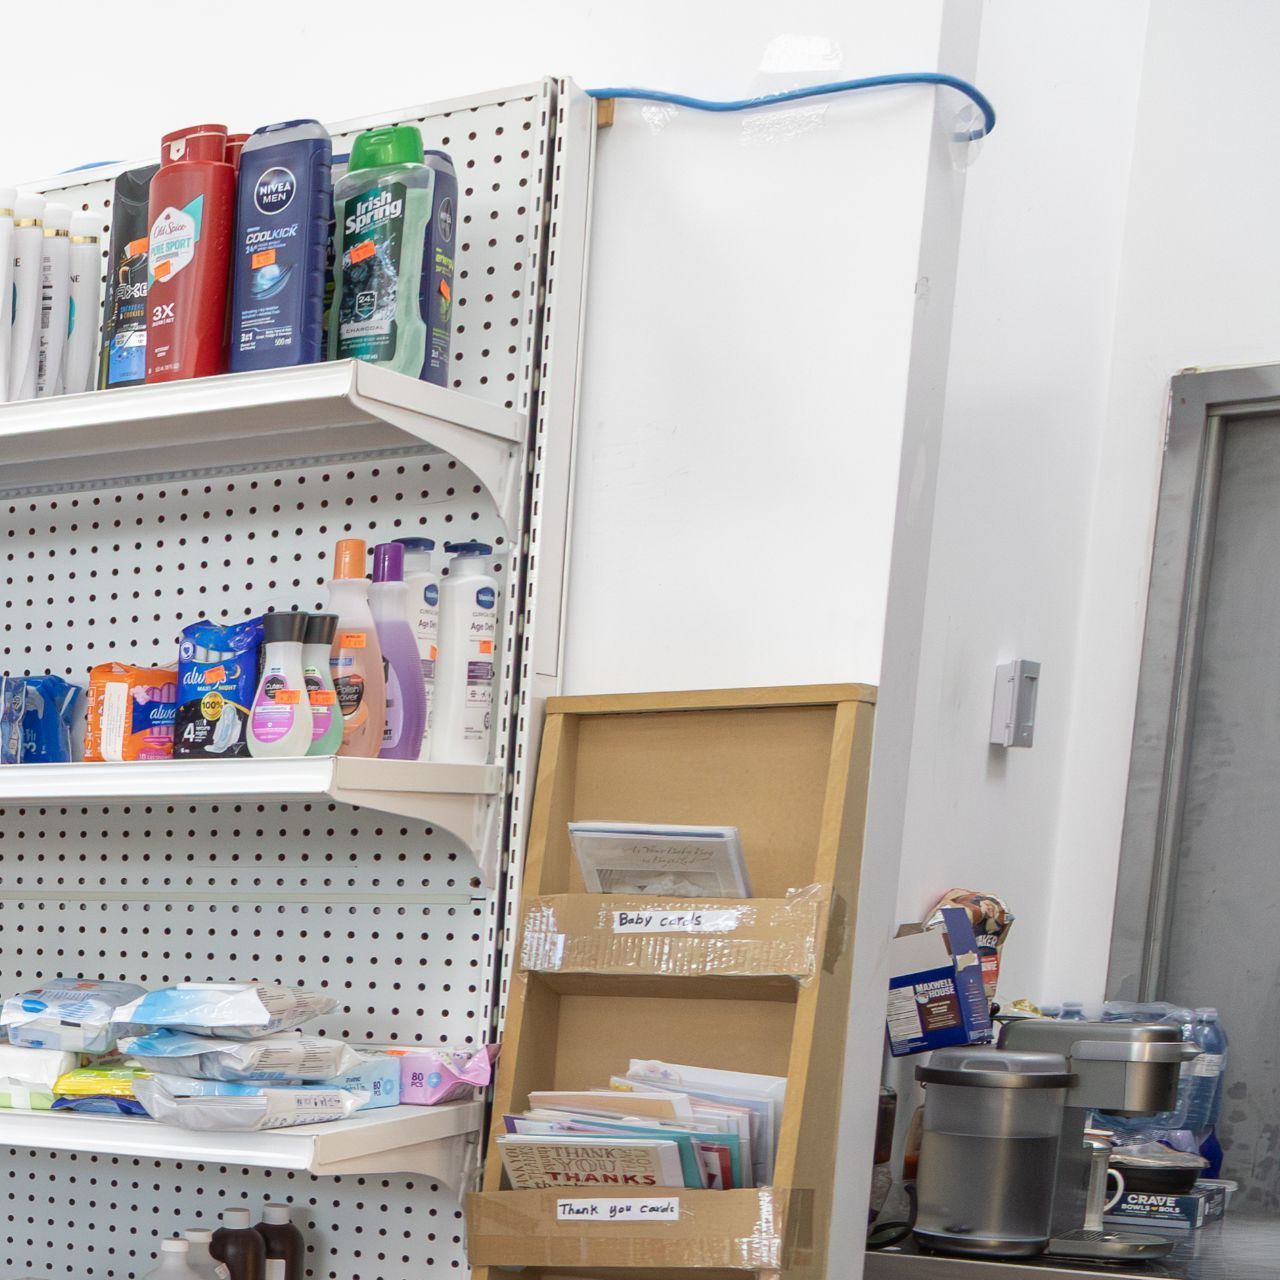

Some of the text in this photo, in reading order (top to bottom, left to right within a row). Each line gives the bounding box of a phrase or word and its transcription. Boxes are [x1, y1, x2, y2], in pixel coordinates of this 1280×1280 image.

[259, 185, 291, 197] NIVEA
[356, 193, 392, 216] Irish
[345, 201, 404, 235] Spring
[153, 305, 174, 321] 3X
[619, 912, 702, 931] Baby cards
[915, 978, 953, 995] MAXWELL
[928, 985, 955, 998] HOUSE
[552, 1145, 616, 1160] THANK
[551, 1170, 656, 1186] THANKS
[1127, 1194, 1176, 1207] CRAVE
[559, 1201, 676, 1217] Thank you cards
